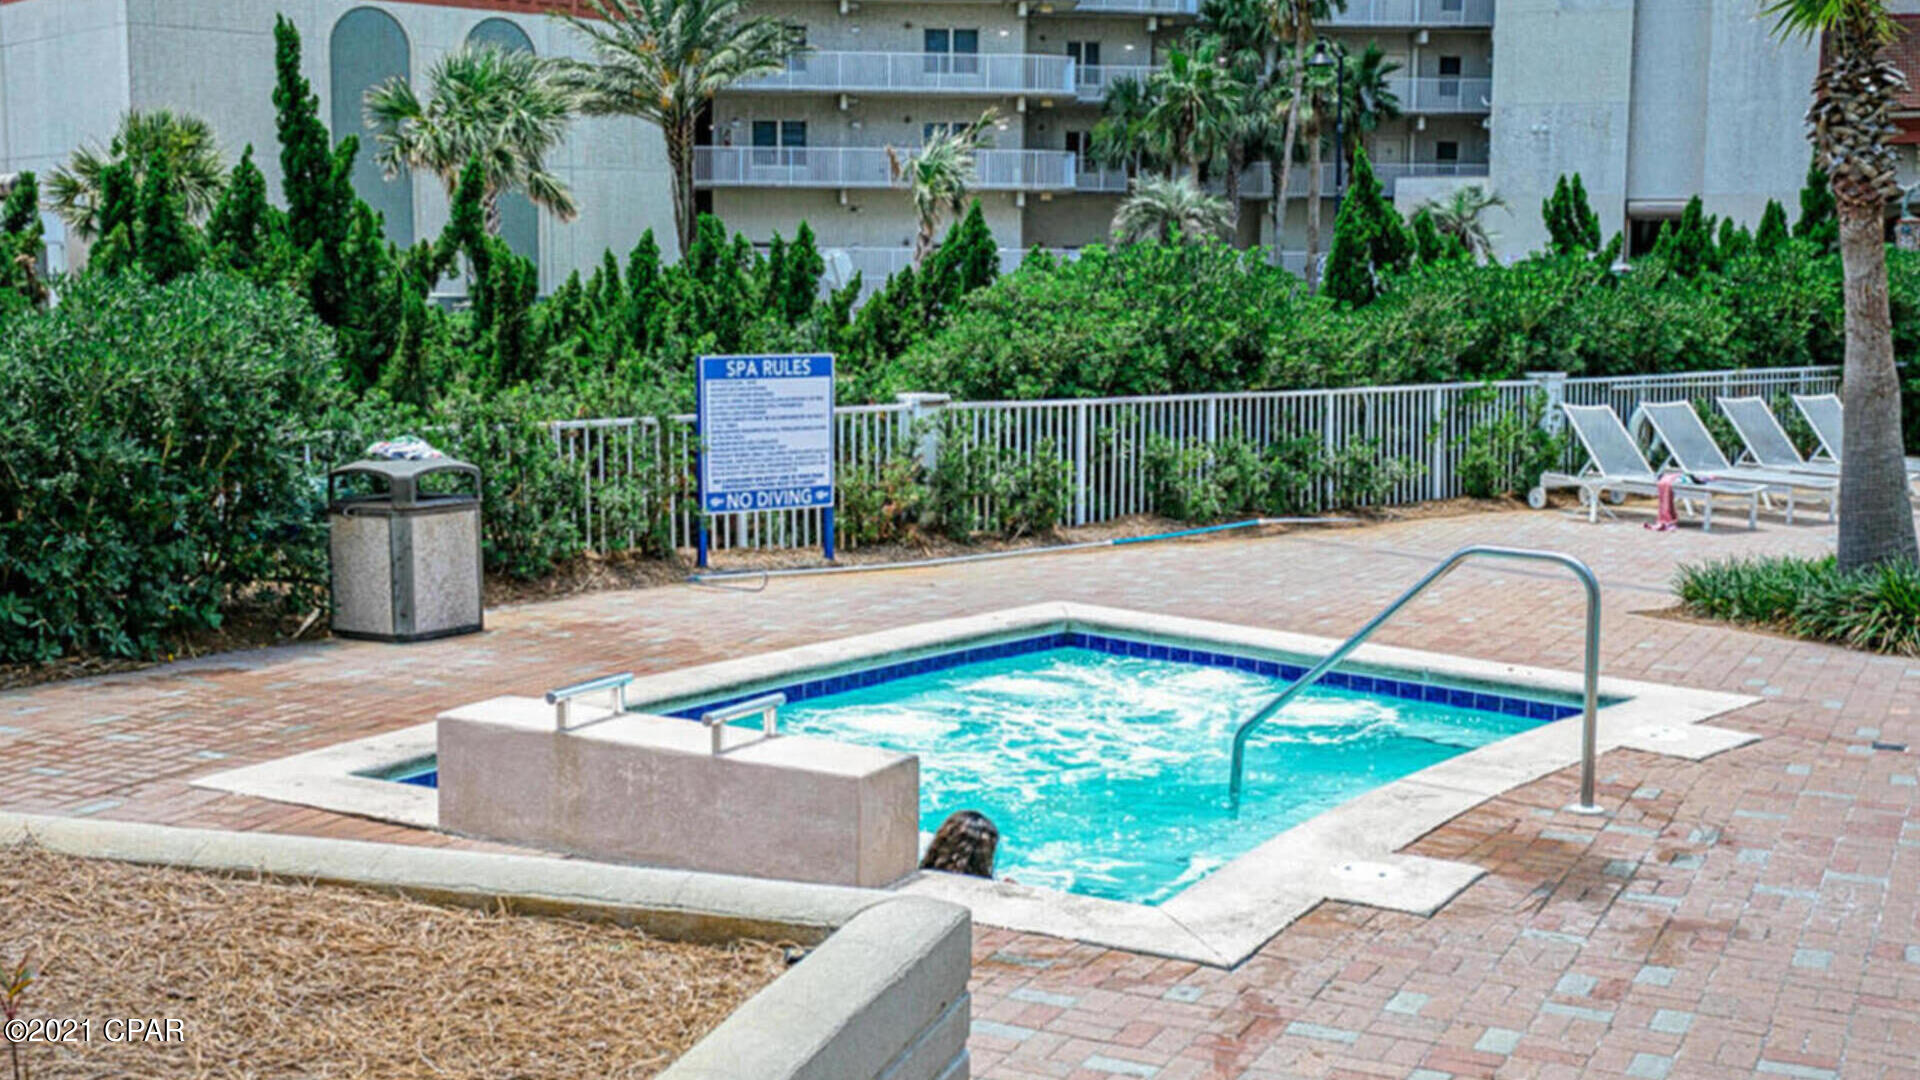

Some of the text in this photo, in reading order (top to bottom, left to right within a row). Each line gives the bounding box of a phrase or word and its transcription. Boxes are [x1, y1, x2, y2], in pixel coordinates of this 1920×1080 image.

[726, 359, 811, 377] SPA RULES
[726, 488, 812, 509] NO DIVING
